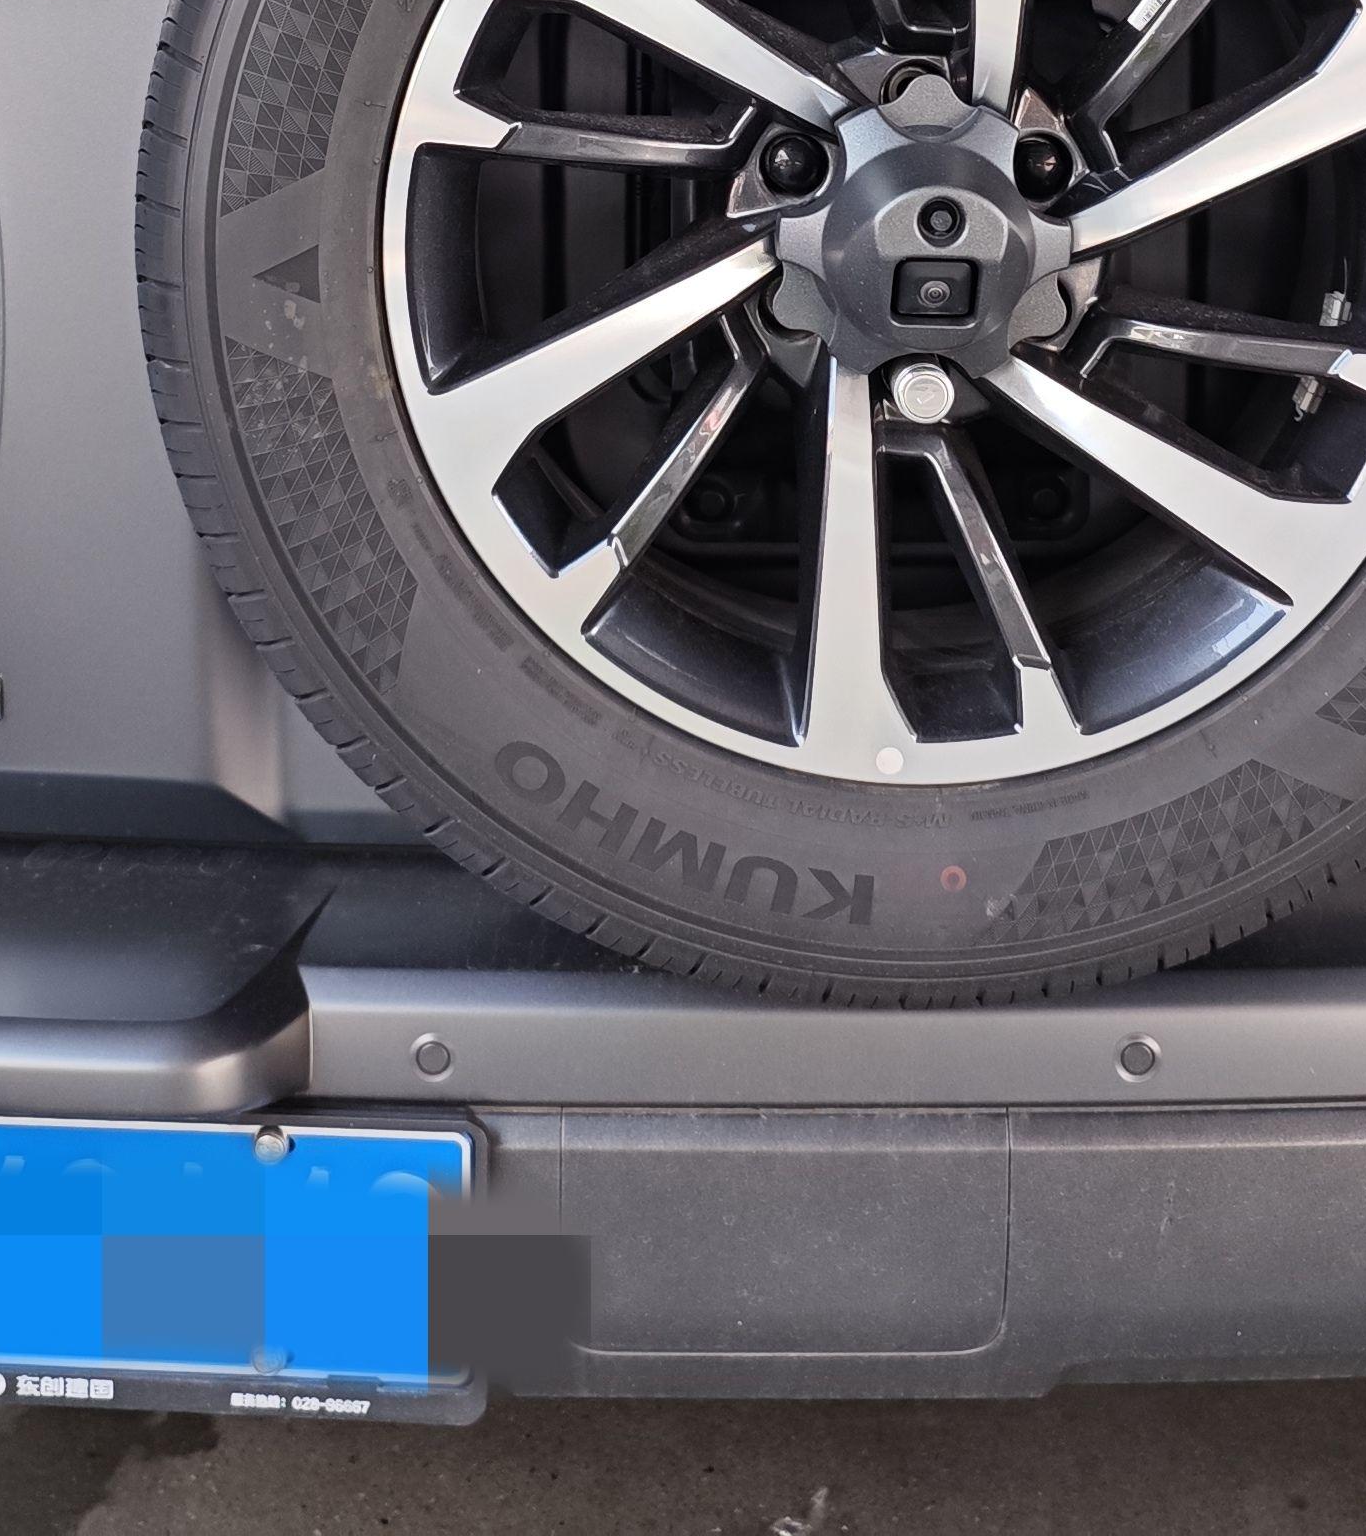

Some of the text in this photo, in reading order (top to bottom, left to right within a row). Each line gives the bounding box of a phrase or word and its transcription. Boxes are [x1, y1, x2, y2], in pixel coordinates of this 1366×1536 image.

[652, 747, 779, 810] TUBELESS
[493, 739, 875, 926] KUMHO
[786, 797, 884, 828] RADIAL
